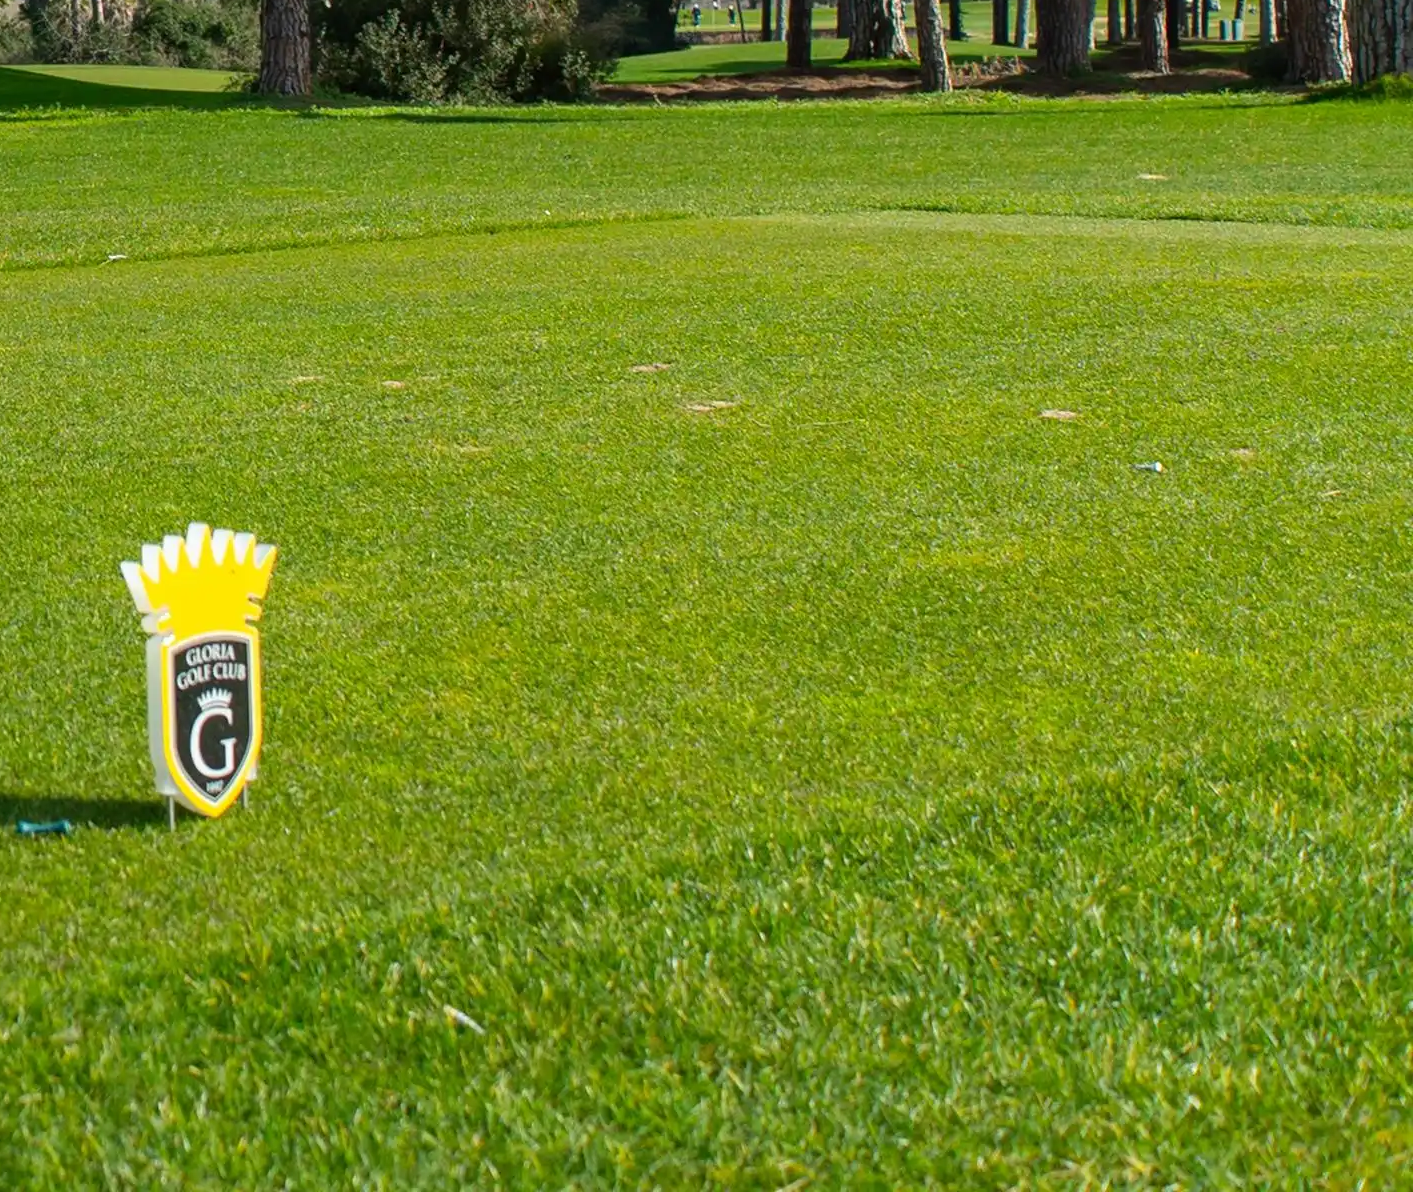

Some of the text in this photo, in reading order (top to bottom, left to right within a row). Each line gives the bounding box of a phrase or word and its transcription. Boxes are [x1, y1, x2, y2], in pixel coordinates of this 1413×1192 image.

[186, 644, 235, 666] GLORIA
[177, 662, 246, 690] GOLF CLUB
[190, 708, 237, 777] G
